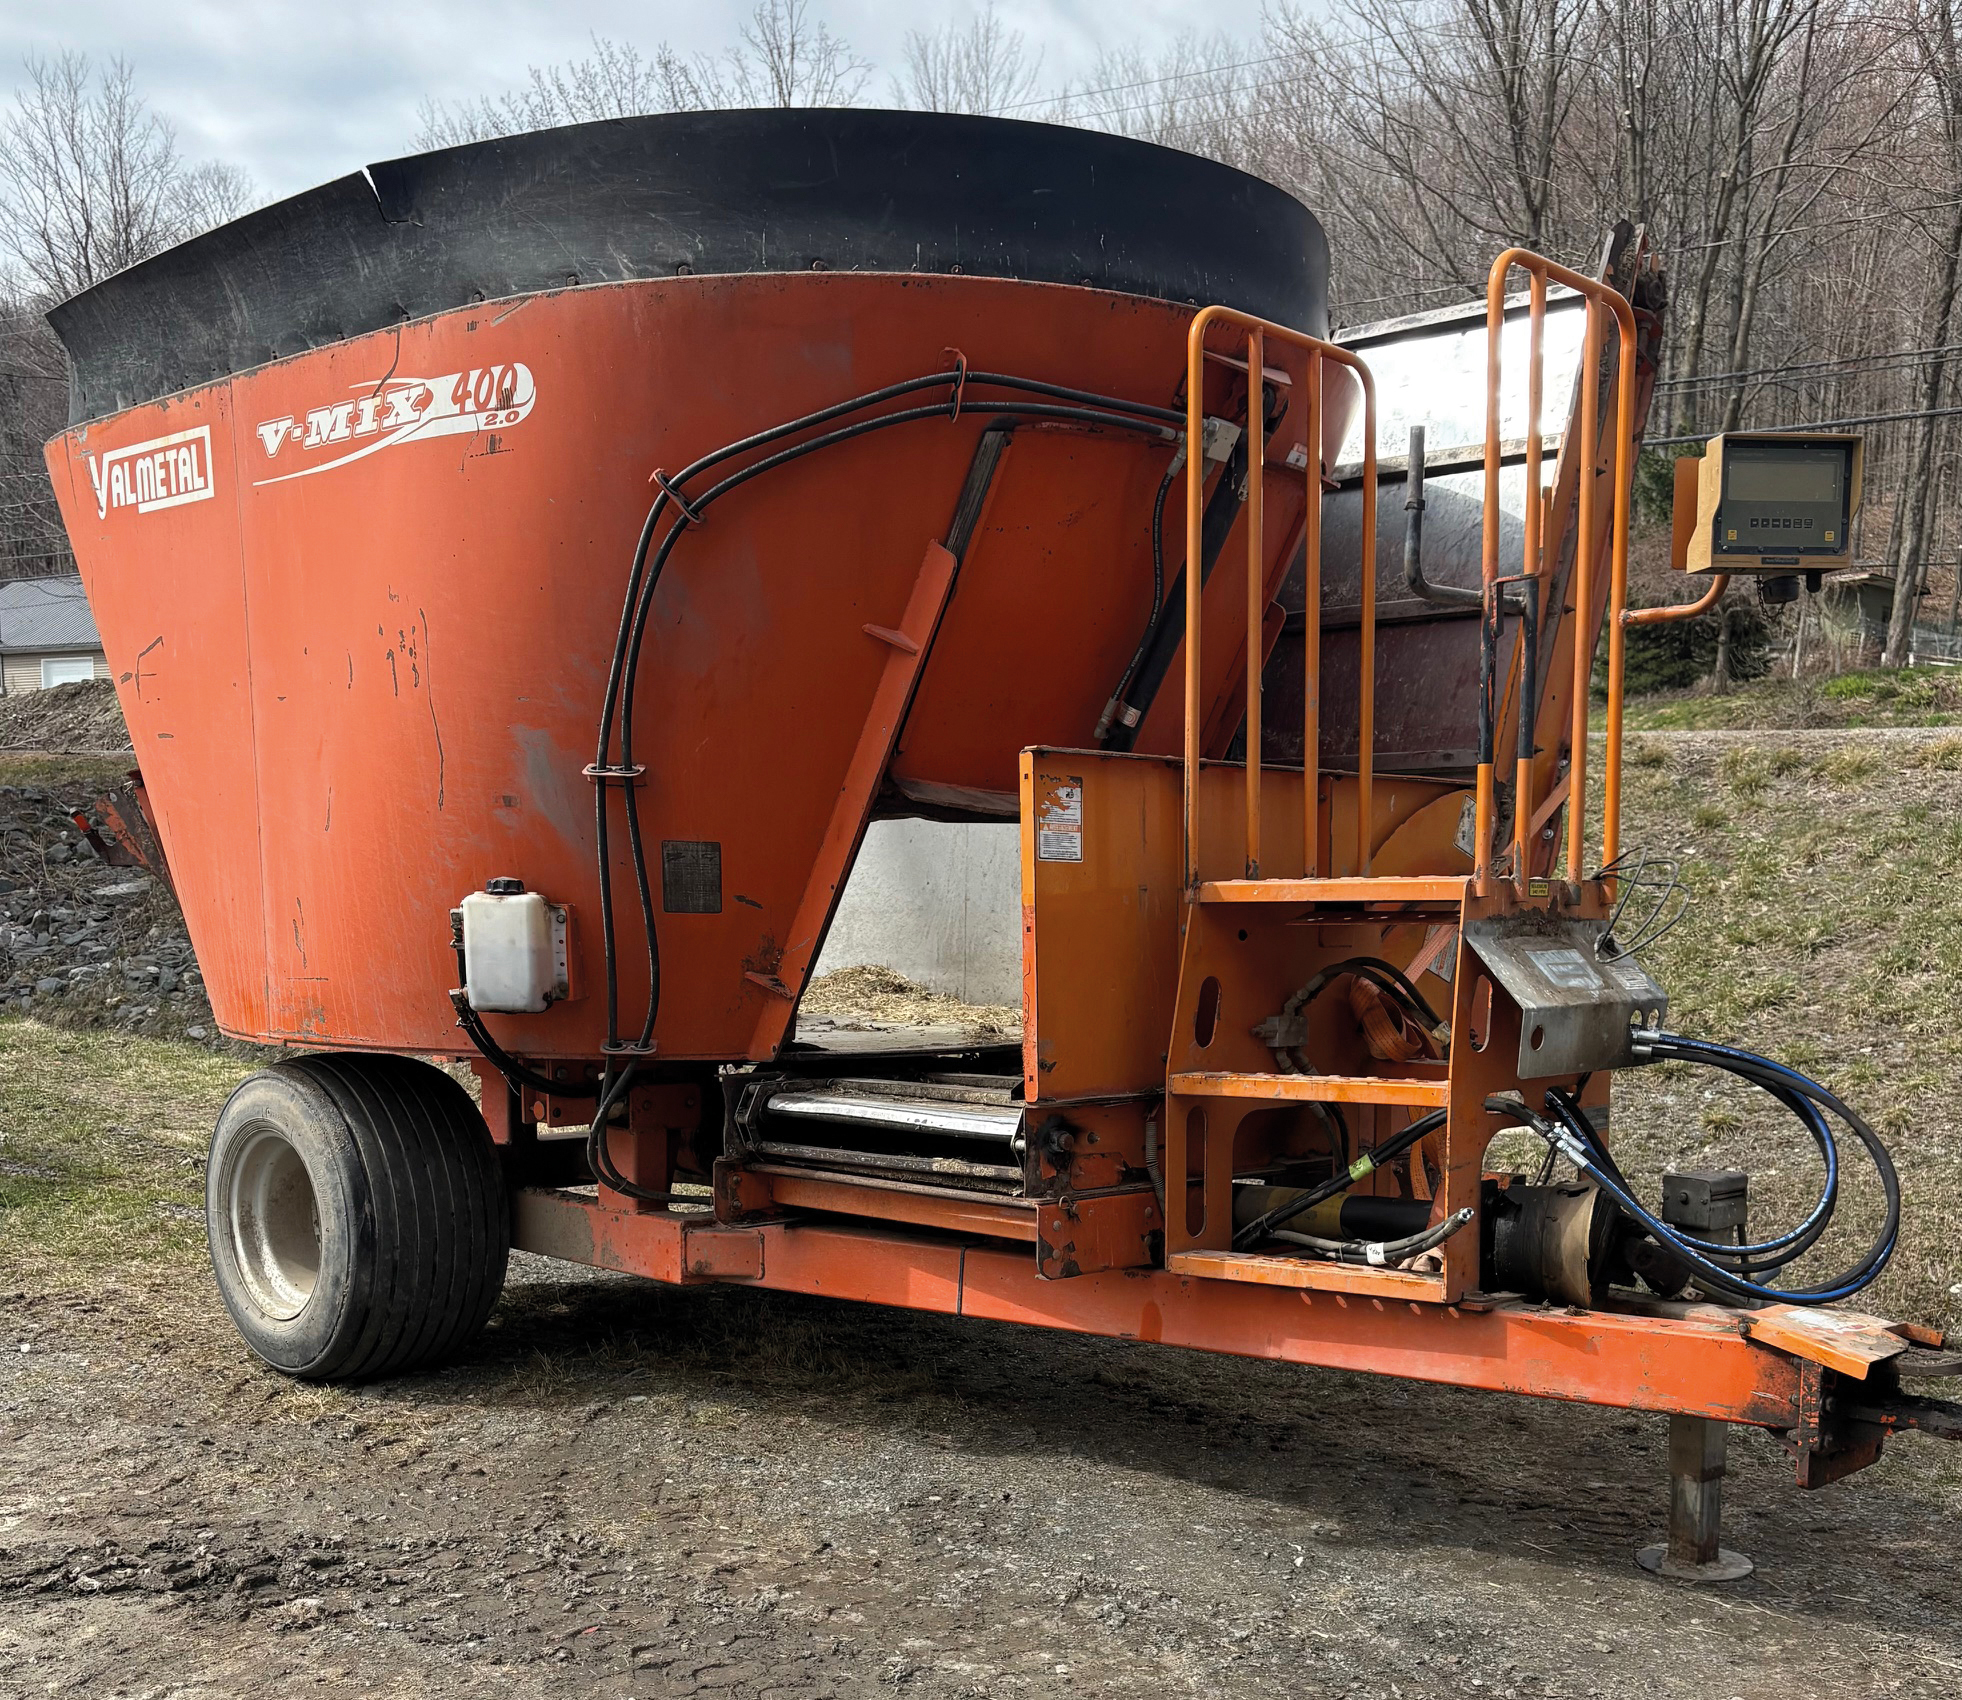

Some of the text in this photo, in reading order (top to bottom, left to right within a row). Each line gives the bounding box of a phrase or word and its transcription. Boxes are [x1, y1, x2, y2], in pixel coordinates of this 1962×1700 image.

[451, 364, 518, 413] 400
[484, 411, 520, 427] 2.0
[89, 442, 206, 520] VALMETAL
